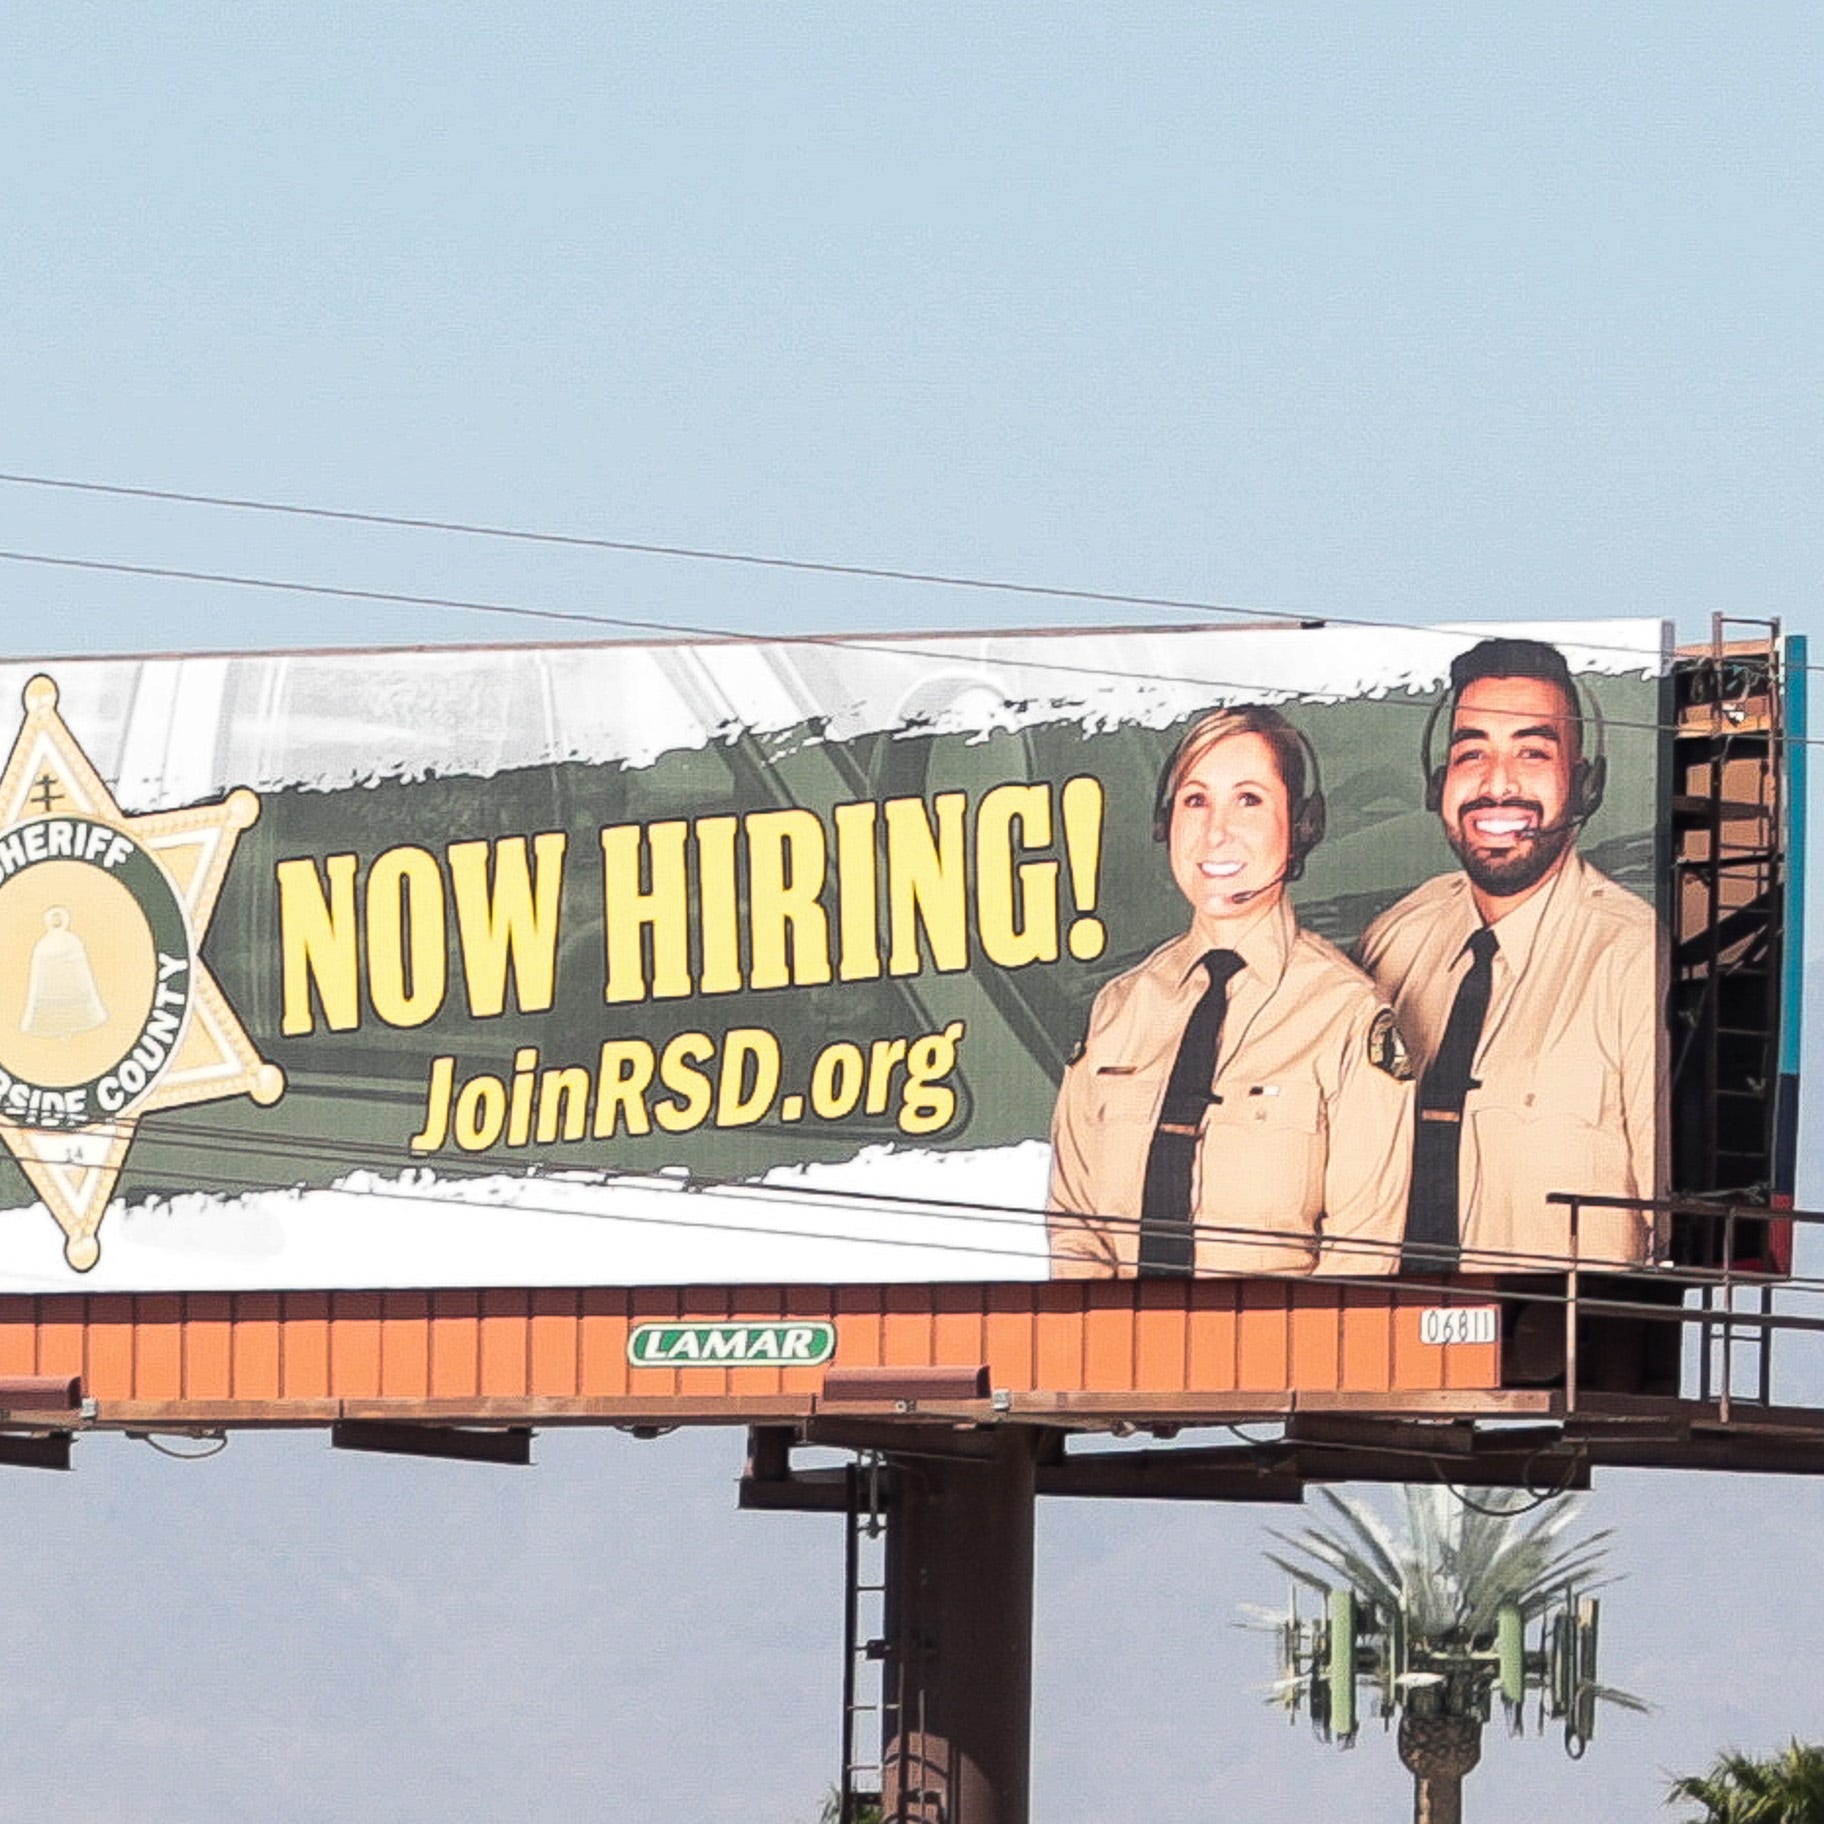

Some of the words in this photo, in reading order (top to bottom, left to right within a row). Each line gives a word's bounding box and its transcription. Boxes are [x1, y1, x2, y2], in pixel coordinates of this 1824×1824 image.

[275, 833, 568, 1036] NOW
[599, 776, 1106, 1005] HIRING!
[96, 952, 189, 1111] COUNTY
[411, 1021, 965, 1156] JoinRSD.org
[643, 1328, 814, 1360] LAMAR
[1427, 1309, 1490, 1342] 06811
